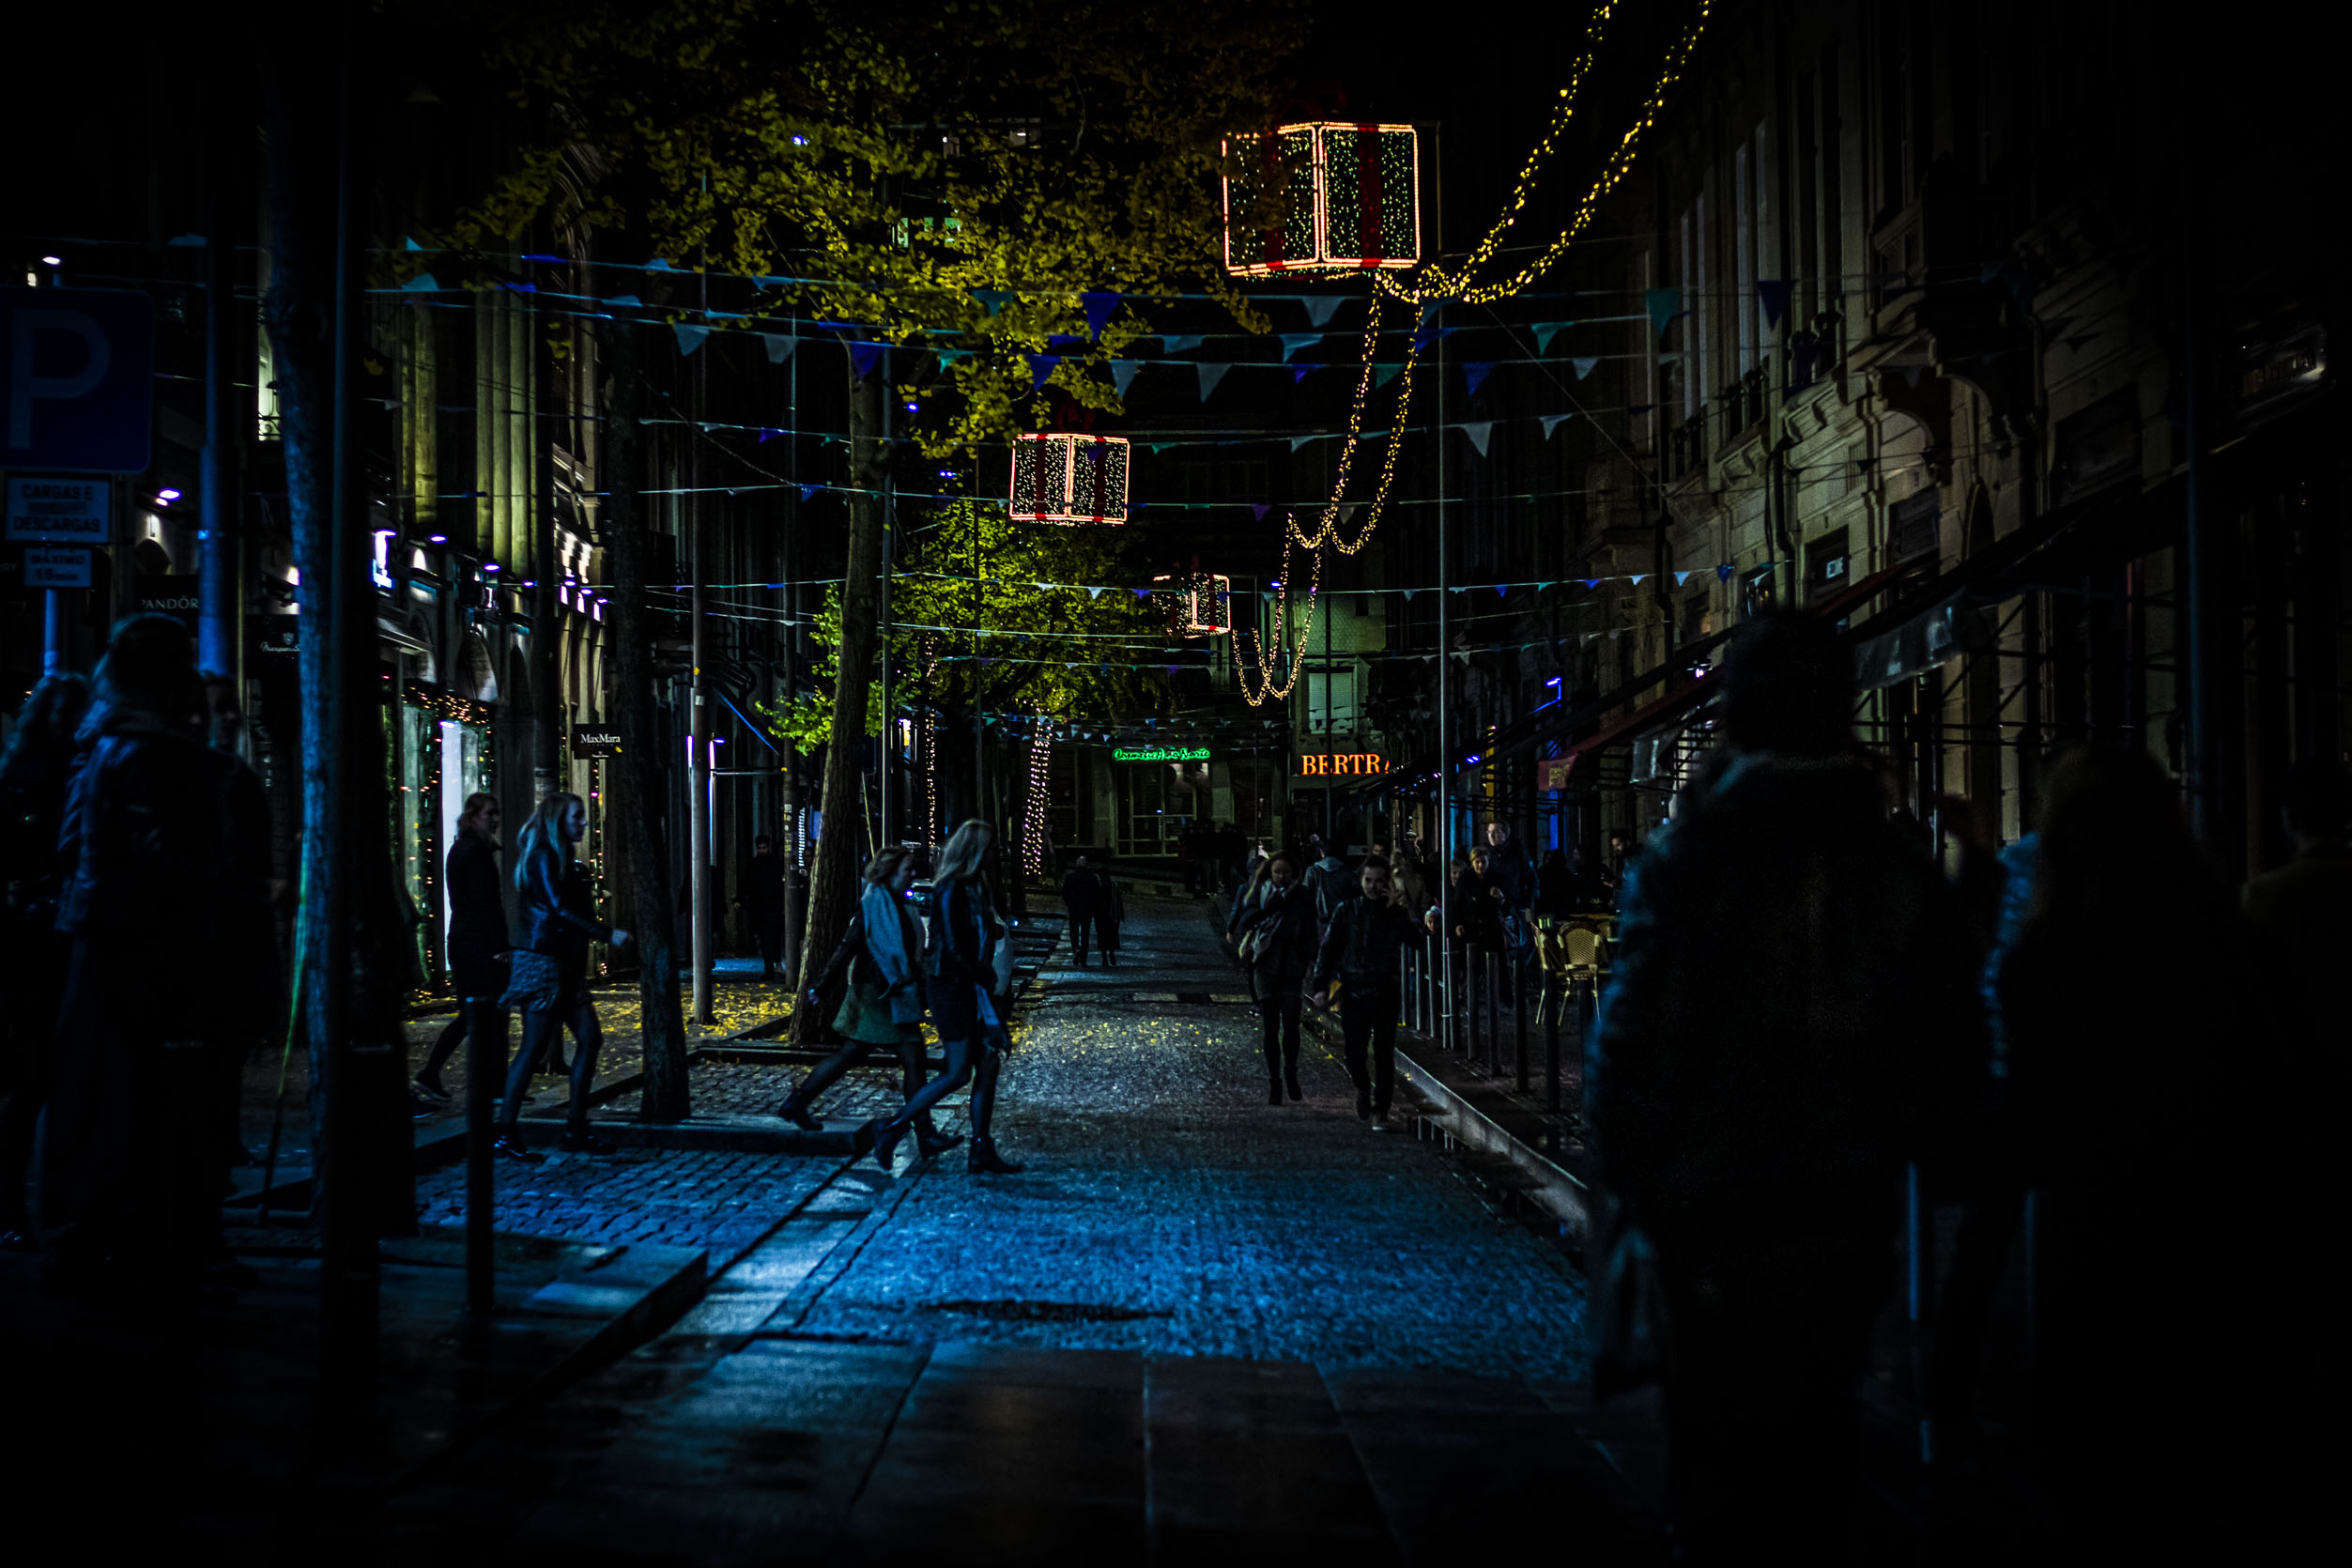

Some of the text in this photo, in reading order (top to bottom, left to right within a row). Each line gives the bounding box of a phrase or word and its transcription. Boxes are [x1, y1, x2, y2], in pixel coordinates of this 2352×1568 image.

[9, 307, 112, 450] P
[23, 484, 95, 501] CARGAS E
[14, 515, 101, 533] DESCARGAS
[140, 595, 199, 609] PANDOR
[580, 732, 622, 744] MaxMara
